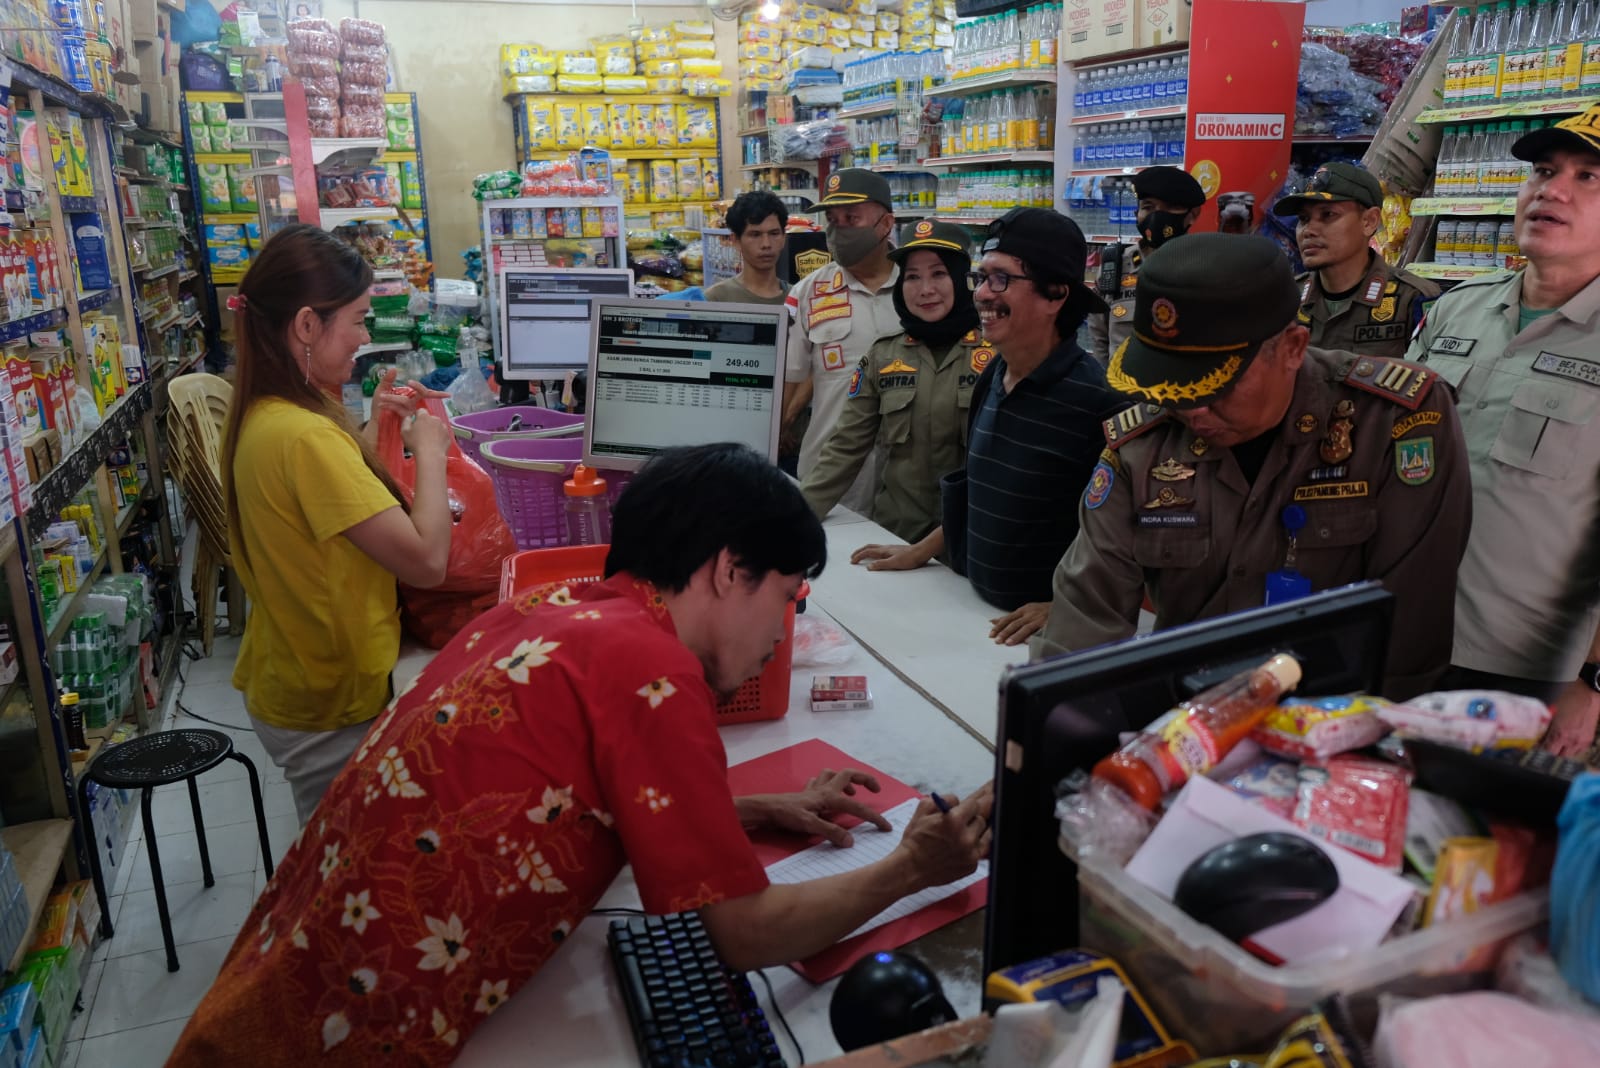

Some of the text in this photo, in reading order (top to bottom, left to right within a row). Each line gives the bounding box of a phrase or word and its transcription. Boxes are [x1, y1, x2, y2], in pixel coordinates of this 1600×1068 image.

[1358, 325, 1403, 339] POL PP
[725, 358, 760, 368] 249.400
[1558, 360, 1577, 370] BEA
[878, 374, 979, 389] CHITRA PO
[1140, 515, 1161, 524] INDRA
